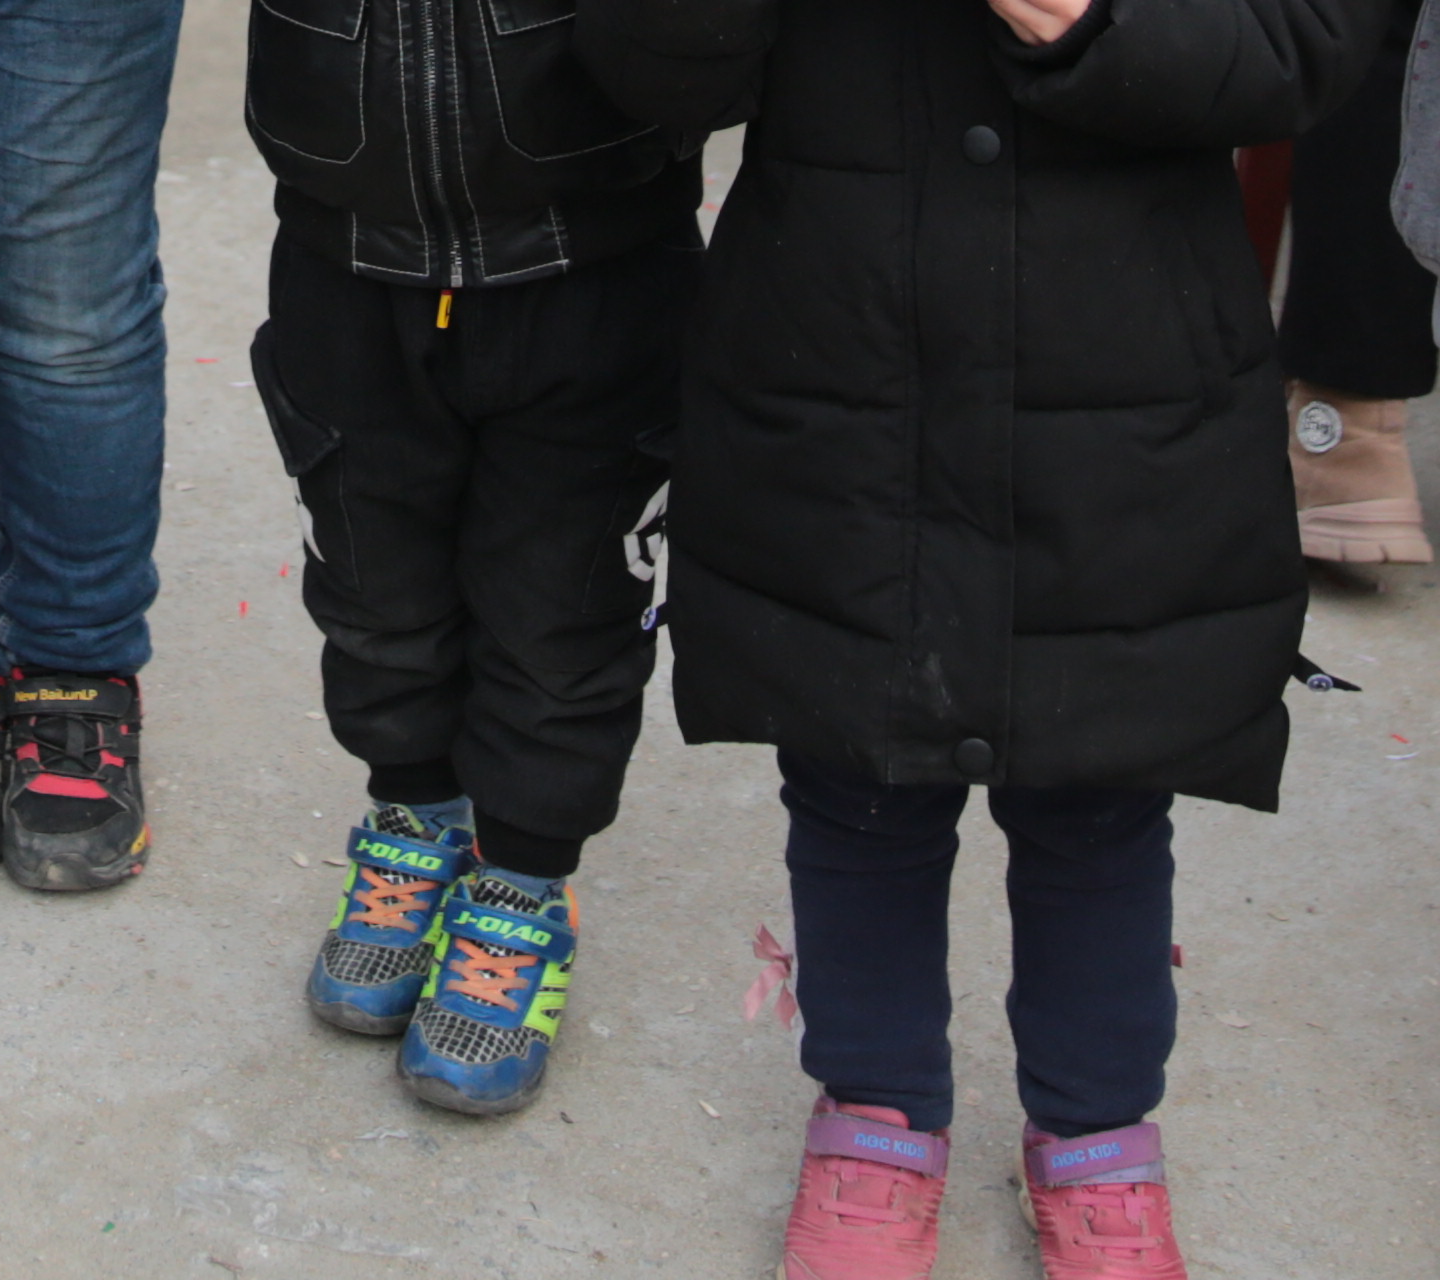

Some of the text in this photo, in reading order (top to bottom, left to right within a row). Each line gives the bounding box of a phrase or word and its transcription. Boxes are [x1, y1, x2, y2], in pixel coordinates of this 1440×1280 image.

[14, 690, 38, 703] New
[355, 838, 443, 871] J-QIAO
[453, 910, 552, 947] J-QIAO
[854, 1132, 928, 1160] ABC KIDS
[1051, 1142, 1122, 1169] ABC KIDS
